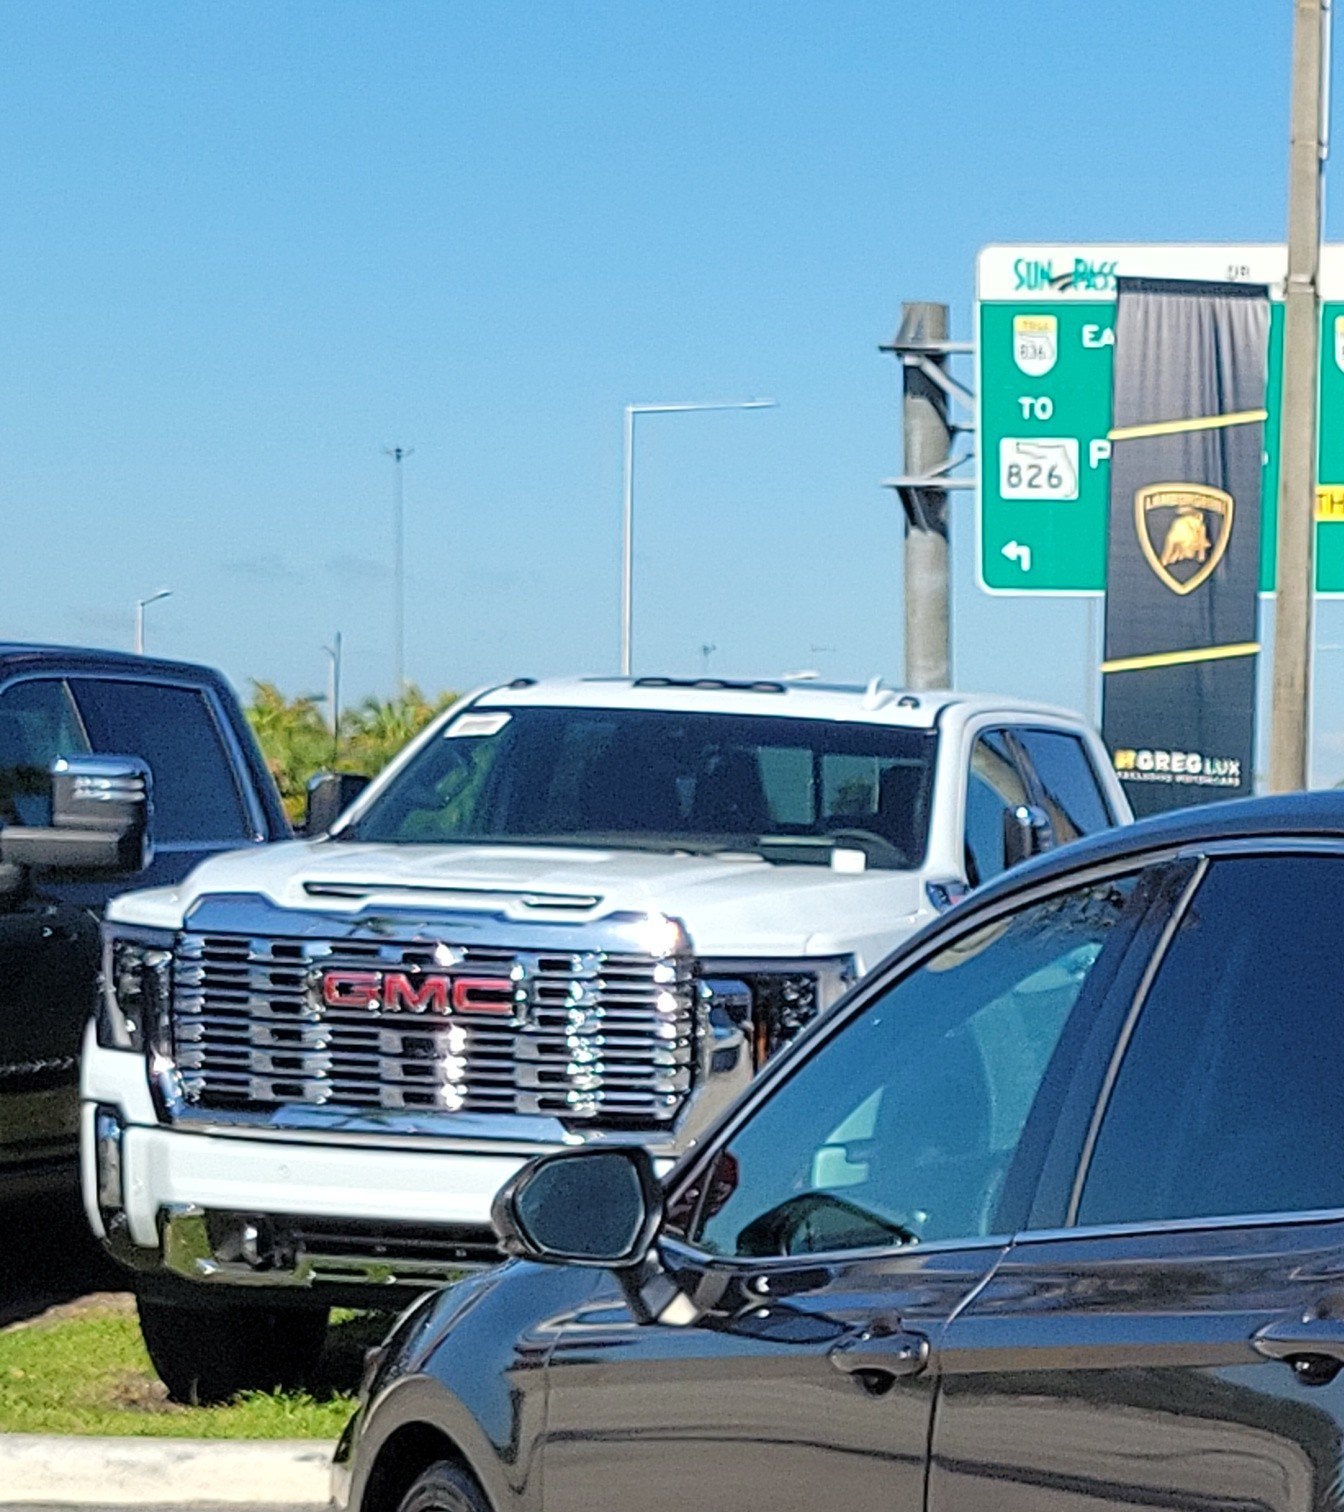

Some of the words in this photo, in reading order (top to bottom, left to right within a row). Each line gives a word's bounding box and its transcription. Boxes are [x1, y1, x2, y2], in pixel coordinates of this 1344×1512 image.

[1081, 324, 1116, 348] EA
[1017, 396, 1054, 420] TO
[1006, 464, 1064, 489] 826
[1203, 757, 1240, 777] LUX
[323, 971, 515, 1016] GMC
